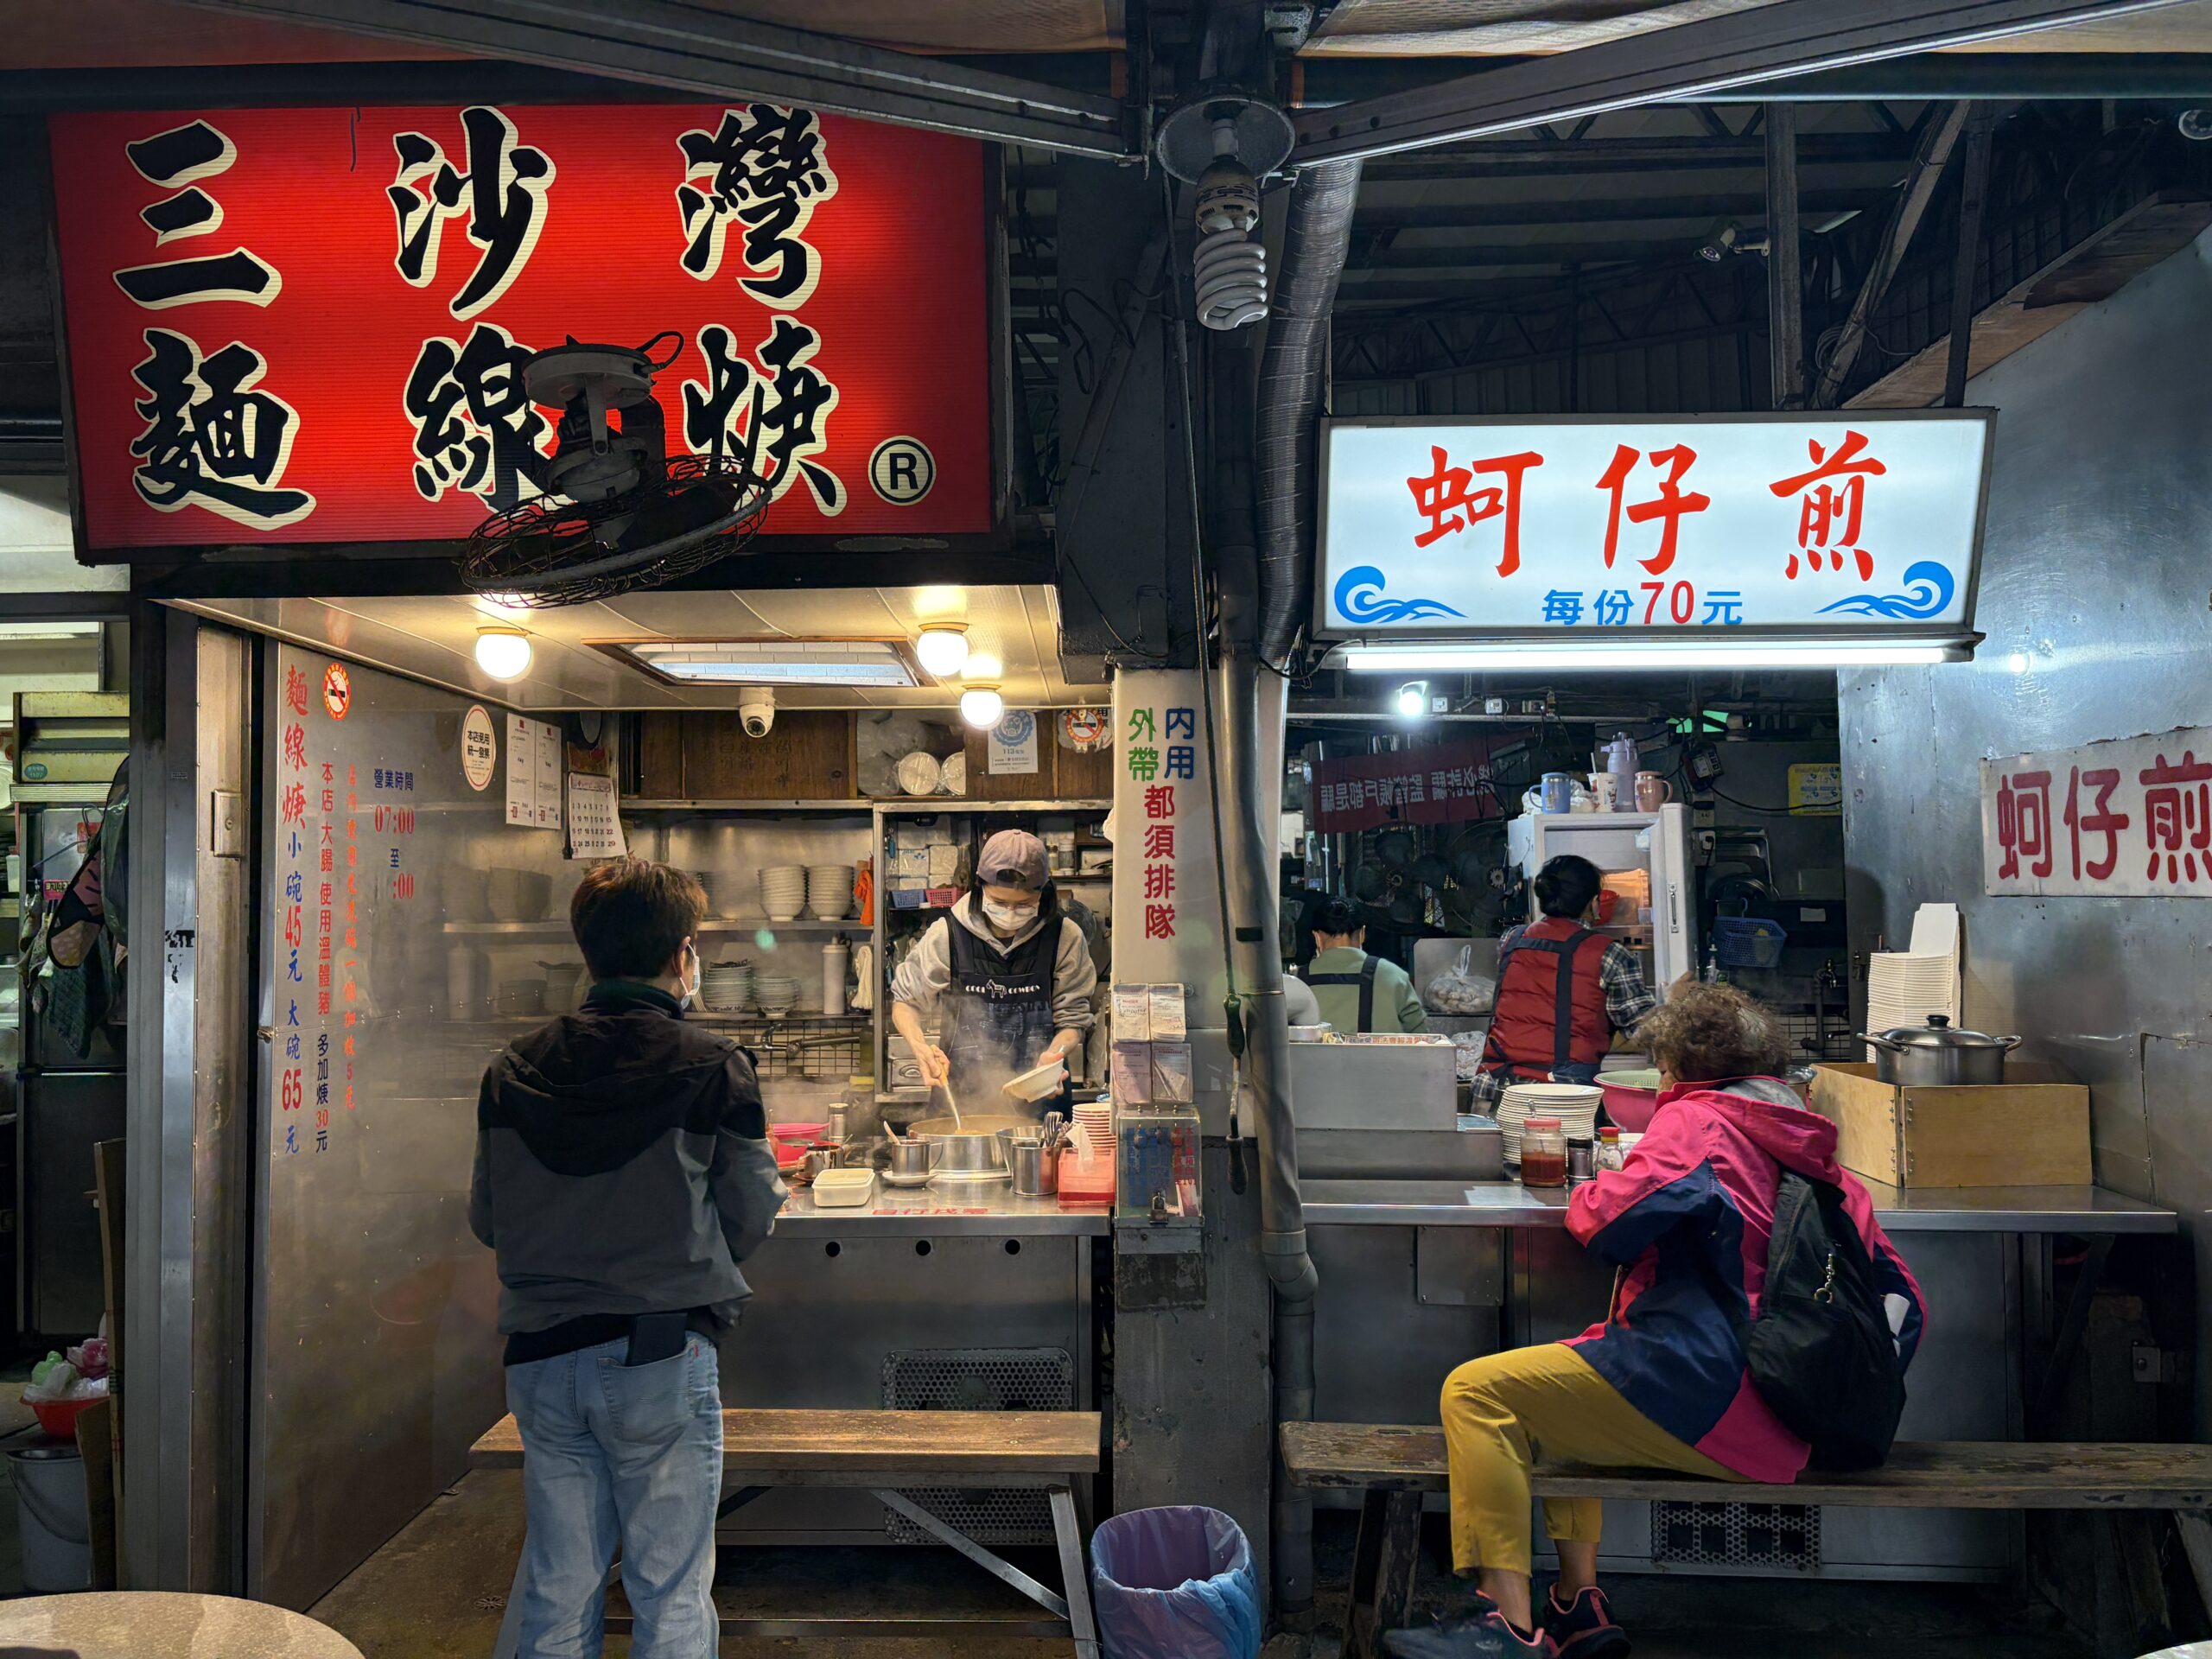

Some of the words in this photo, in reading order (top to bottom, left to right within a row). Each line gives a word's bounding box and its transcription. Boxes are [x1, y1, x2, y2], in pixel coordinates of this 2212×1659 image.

[111, 103, 840, 321] 三沙灣
[1406, 429, 1887, 582] 蚵仔煎
[1541, 580, 1744, 626] 每份70元
[467, 729, 490, 745] 本店免用
[1128, 707, 1160, 782] 外帶
[1164, 707, 1196, 779] 內用
[374, 767, 414, 791] 營業時間
[1997, 750, 2212, 883] 蚵仔煎
[390, 849, 400, 868] 至
[1144, 785, 1176, 939] 都須排隊
